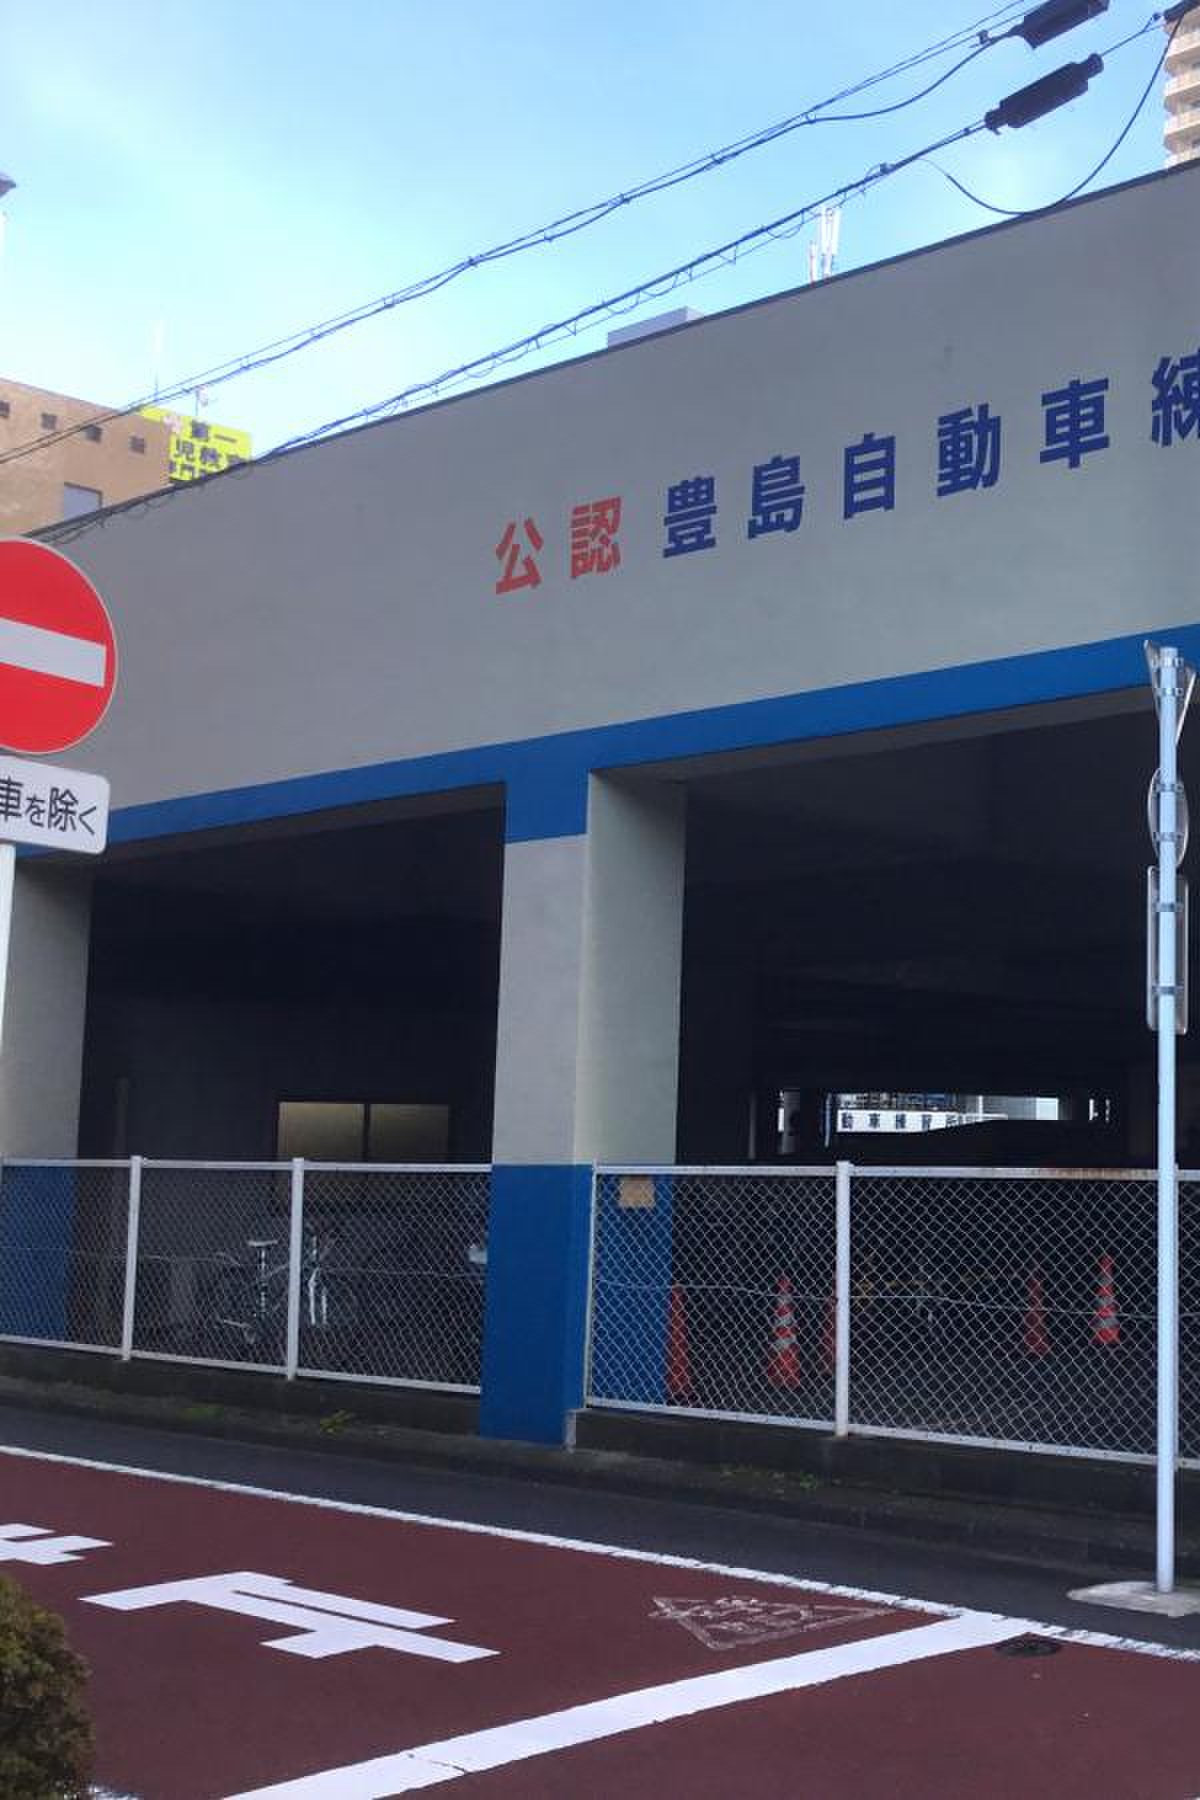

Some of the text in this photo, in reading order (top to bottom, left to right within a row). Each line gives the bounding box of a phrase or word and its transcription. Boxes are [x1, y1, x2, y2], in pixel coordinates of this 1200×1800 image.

[495, 495, 623, 594] 公認
[0, 775, 97, 836] 車を除く
